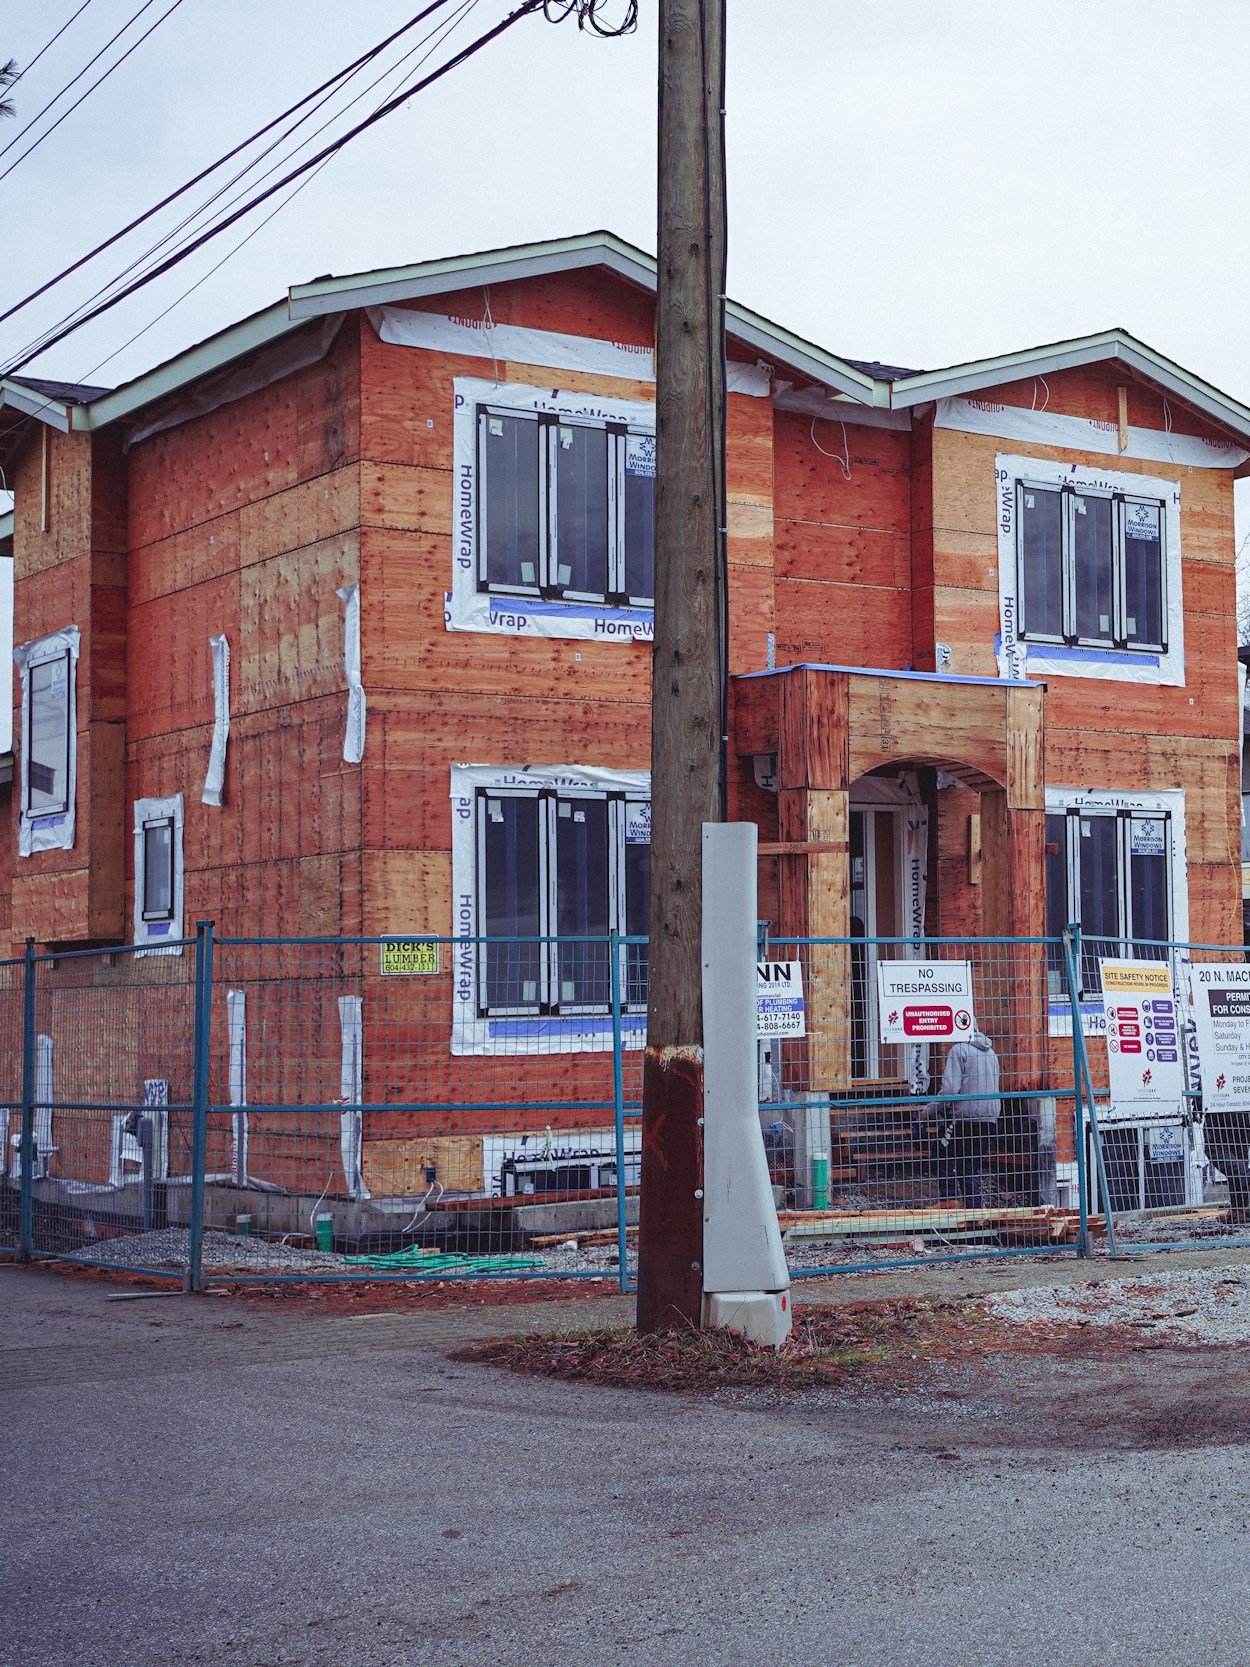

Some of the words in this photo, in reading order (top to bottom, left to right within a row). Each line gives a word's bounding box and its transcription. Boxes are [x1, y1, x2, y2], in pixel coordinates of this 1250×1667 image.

[1133, 841, 1163, 849] WINDOWS
[385, 953, 435, 964] LUMBER
[918, 968, 934, 979] NO
[1104, 972, 1118, 980] SITE
[1119, 973, 1144, 981] SAFETY
[1144, 974, 1168, 982] NOTICE
[1199, 971, 1212, 982] 20
[1214, 971, 1225, 982] N.
[890, 983, 963, 993] TRESPASSING
[765, 998, 798, 1006] PLUMBING
[764, 1005, 793, 1013] HEATING
[1212, 1005, 1229, 1014] FOR
[1213, 1020, 1239, 1029] Monday
[1214, 1031, 1241, 1042] Saturday
[1215, 1043, 1239, 1053] Sunday
[1239, 1042, 1244, 1050] &
